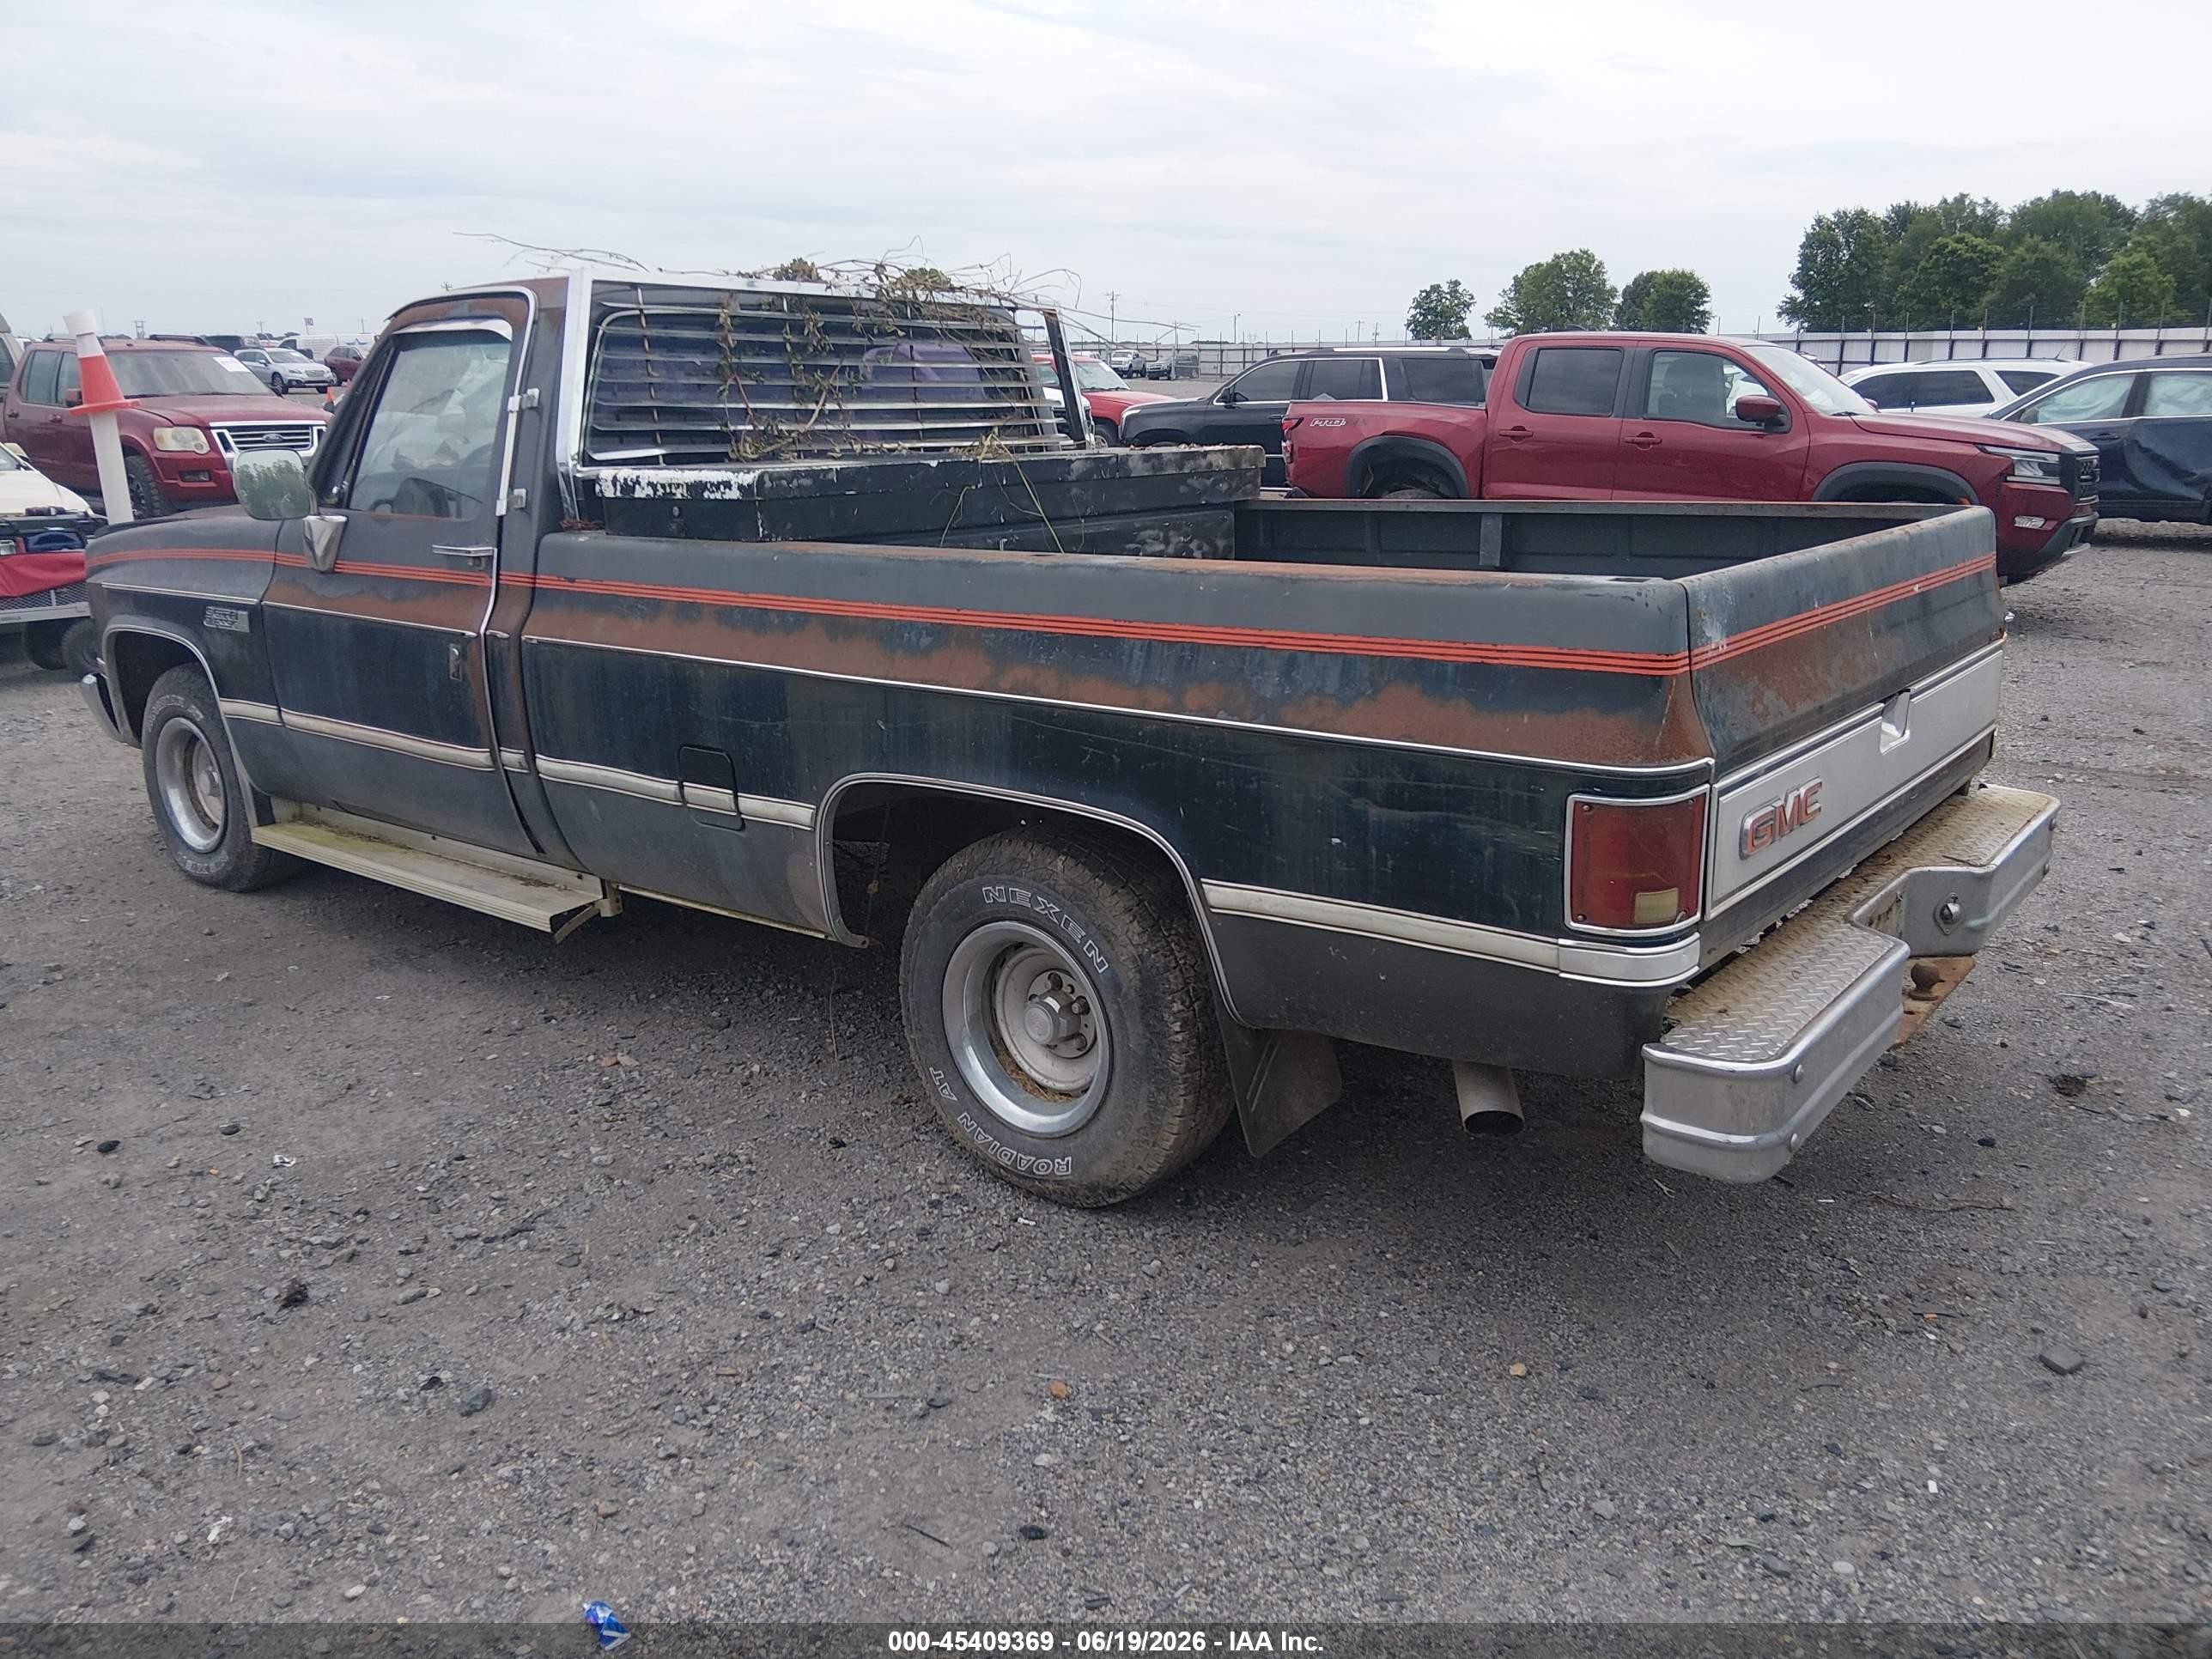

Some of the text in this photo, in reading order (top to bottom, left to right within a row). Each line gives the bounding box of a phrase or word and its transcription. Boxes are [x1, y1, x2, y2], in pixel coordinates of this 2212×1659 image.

[1739, 775, 1822, 860] GMC
[981, 885, 1109, 974] NEXEN
[928, 1066, 1073, 1176] ROADIAN AT
